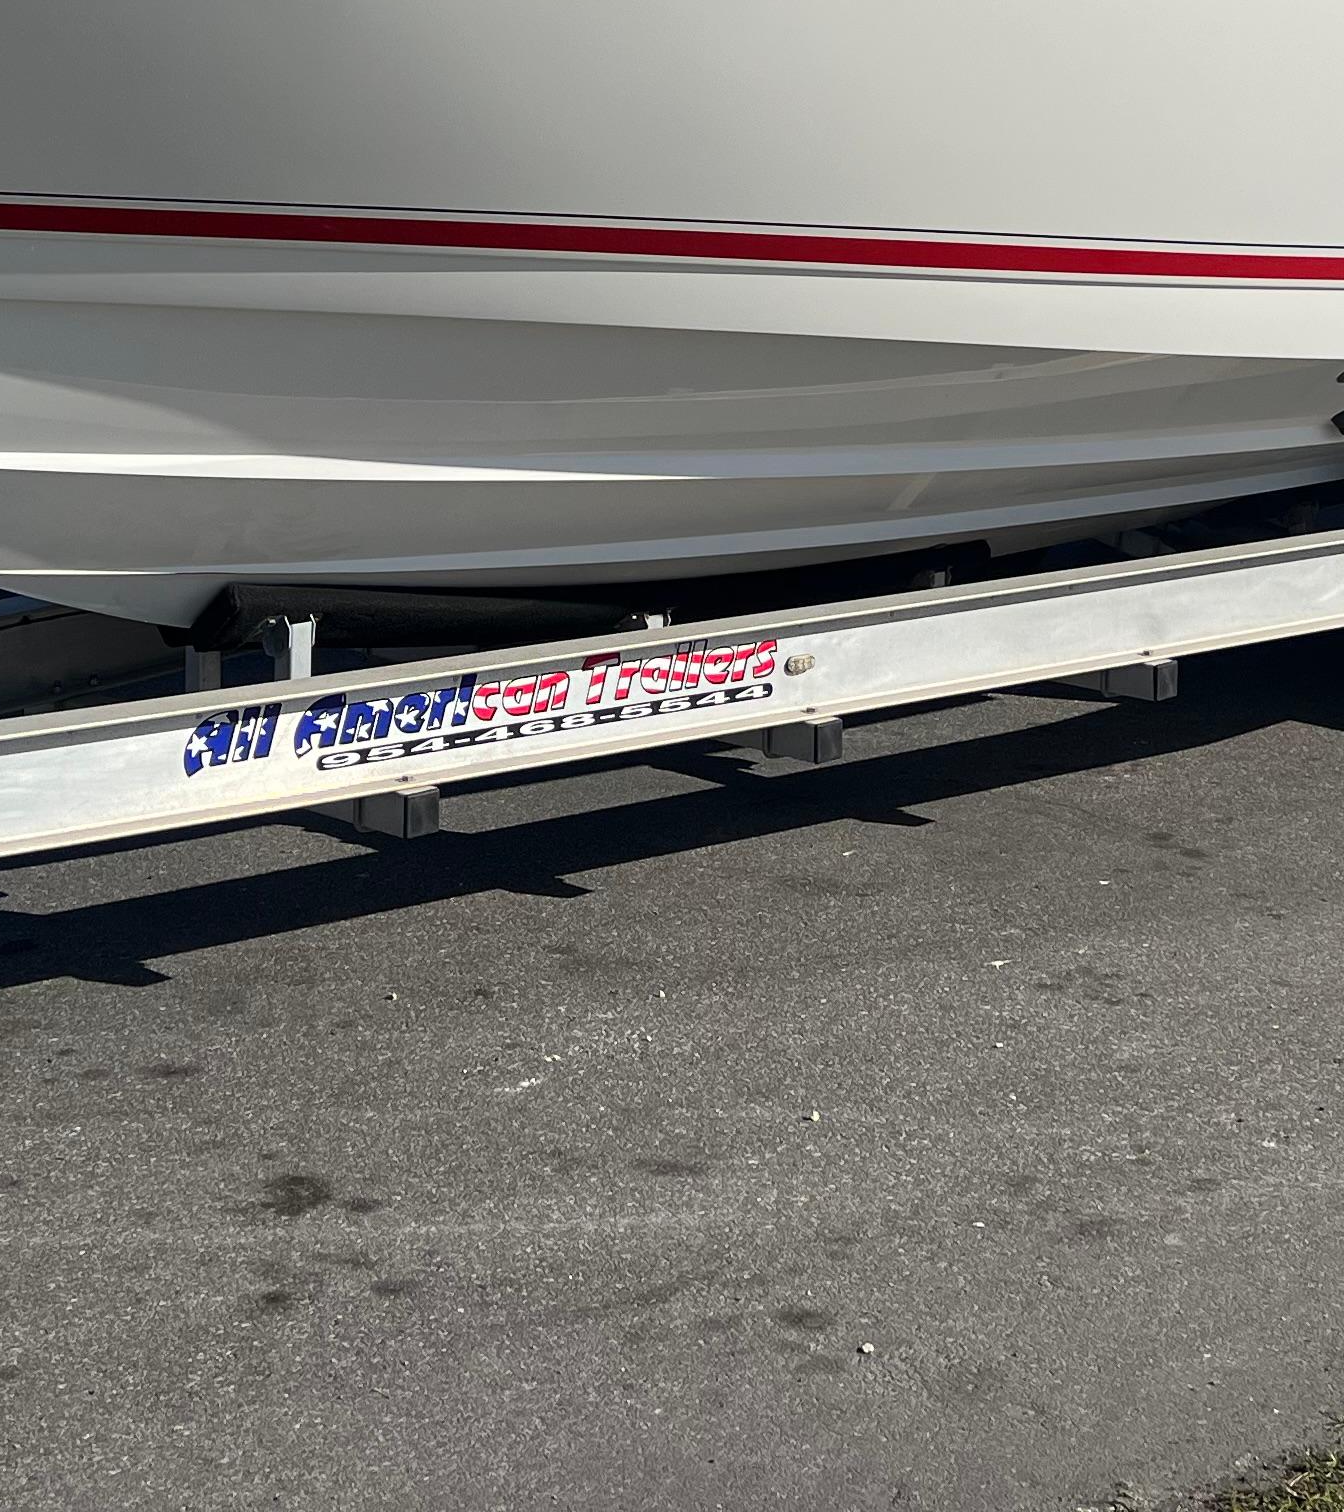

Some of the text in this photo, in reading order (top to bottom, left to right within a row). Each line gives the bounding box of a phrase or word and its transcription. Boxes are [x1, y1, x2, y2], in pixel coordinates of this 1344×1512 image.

[183, 703, 282, 778] All
[582, 638, 780, 706] Trailers
[320, 685, 770, 769] 954-468-5544
